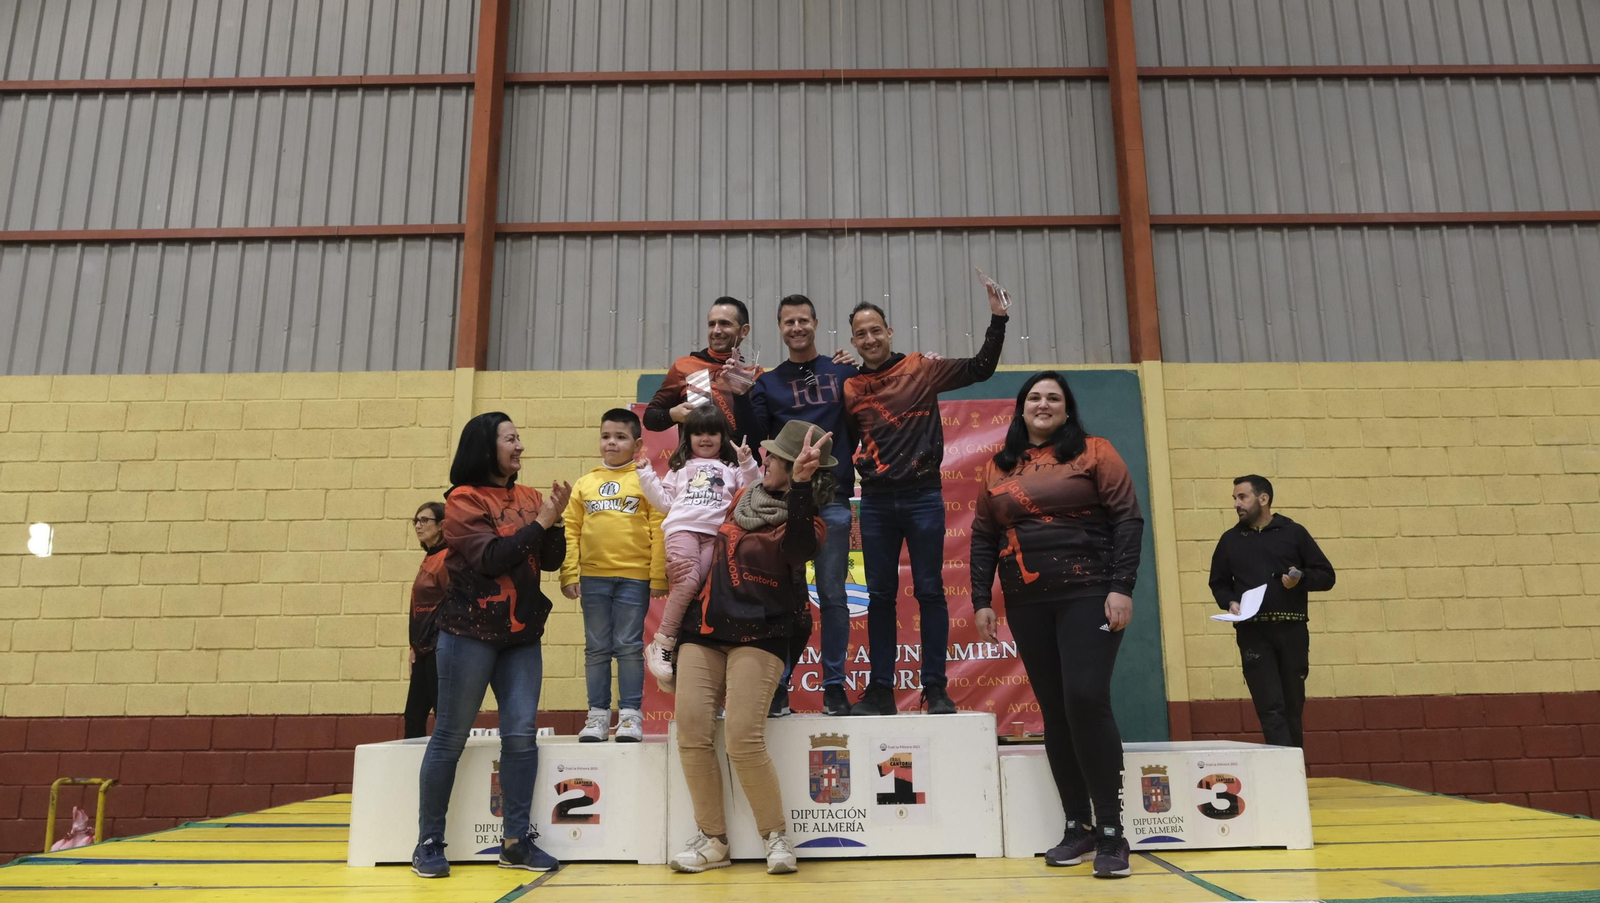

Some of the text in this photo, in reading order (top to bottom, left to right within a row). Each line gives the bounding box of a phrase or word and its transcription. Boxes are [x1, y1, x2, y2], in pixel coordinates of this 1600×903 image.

[1008, 482, 1019, 494] LA
[730, 530, 739, 541] LA
[742, 571, 779, 588] Cantoria
[877, 753, 926, 805] 1
[551, 777, 601, 825] 2
[1196, 773, 1246, 820] 3
[791, 806, 867, 820] DIPUTACIÓN
[793, 819, 865, 833] DE ALMERÍA
[1132, 815, 1184, 827] DIPUTACIÓN
[1134, 823, 1184, 836] DE ALMERÍA
[475, 834, 489, 844] DE
